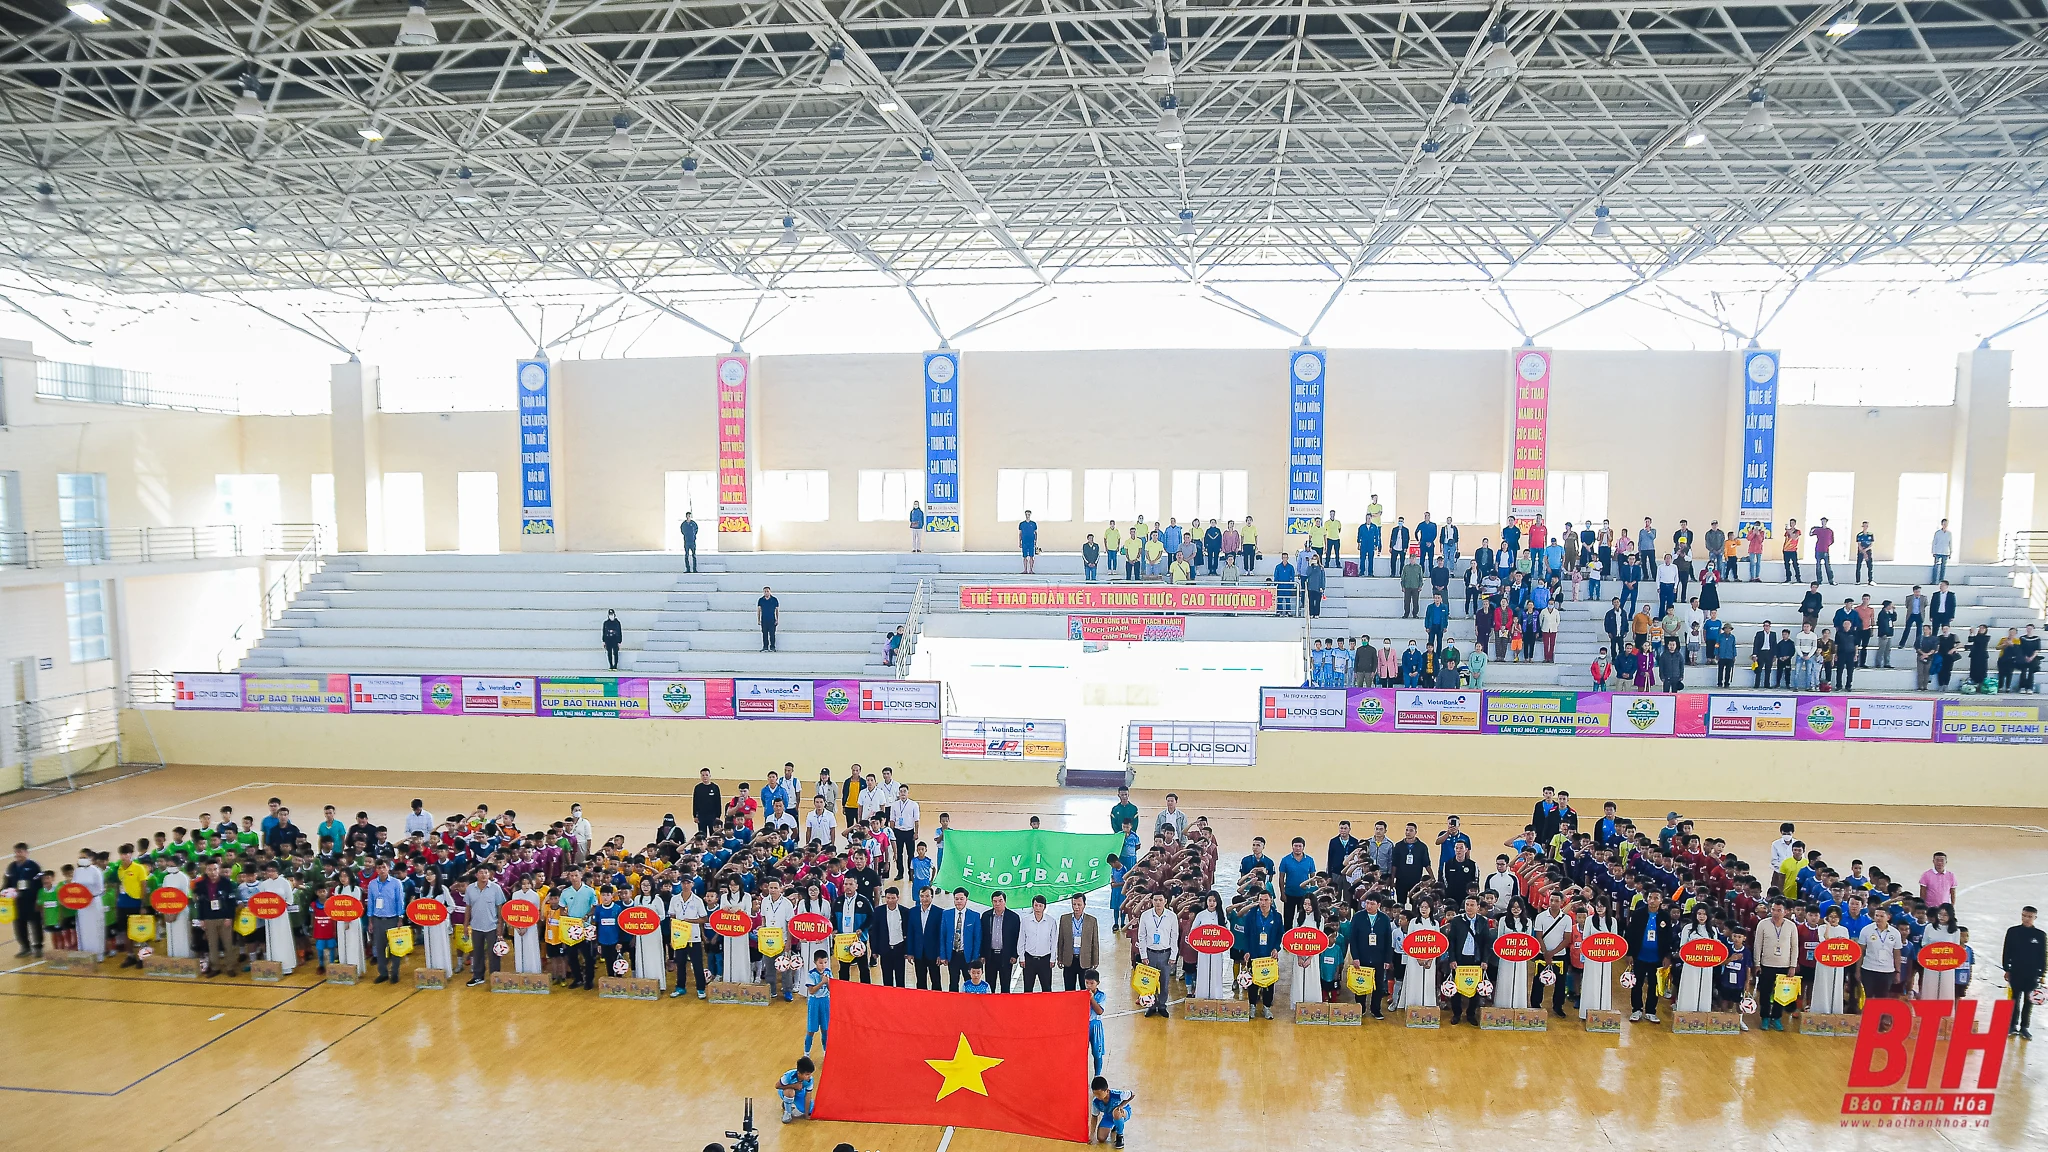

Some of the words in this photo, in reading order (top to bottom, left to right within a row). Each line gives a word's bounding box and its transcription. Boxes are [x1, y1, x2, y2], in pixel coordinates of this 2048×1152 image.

[931, 384, 940, 402] THỂ
[941, 384, 952, 402] THAO
[1519, 385, 1529, 400] THỂ
[1531, 385, 1544, 400] THAO
[1518, 408, 1533, 422] MANG
[1534, 408, 1544, 422] LẠI
[970, 588, 992, 605] THỂ
[997, 592, 1027, 605] THAO
[1031, 590, 1065, 605] ĐOÀN
[1068, 589, 1096, 607] KẾT,
[1101, 593, 1138, 606] TRUNG
[1143, 591, 1177, 608] THỰC,
[1181, 593, 1205, 606] CAO
[1210, 592, 1256, 608] THƯỢNG
[1261, 594, 1265, 606] !
[248, 694, 264, 702] CUP
[292, 694, 320, 703] THANH
[542, 699, 560, 707] CUP
[586, 700, 616, 708] THANH
[1288, 708, 1318, 716] LONG
[1489, 714, 1508, 722] CUP
[1539, 716, 1574, 724] THANH
[1578, 714, 1599, 724] HÓA
[1944, 724, 1966, 732] CUP
[2002, 724, 2039, 733] THANH
[1170, 743, 1211, 752] LONG
[1215, 744, 1246, 752] SON
[967, 854, 1099, 868] LIVING
[794, 921, 816, 934] TRỌNG
[816, 921, 828, 933] TÀI
[1202, 928, 1220, 938] HUYỆN
[1294, 932, 1316, 941] HUYỆN
[1415, 934, 1436, 943] HUYỆN
[1506, 938, 1517, 948] THỊ
[1518, 938, 1528, 946] XÃ
[1594, 938, 1614, 947] HUYỆN
[1193, 939, 1210, 948] QUẢNG
[1212, 940, 1230, 948] XƯƠNG
[1290, 942, 1303, 951] YÊN
[1304, 944, 1320, 953] ĐỊNH
[1828, 944, 1848, 952] HUYỆN
[1410, 946, 1426, 954] QUAN
[1428, 946, 1440, 954] HÓA
[1500, 948, 1517, 956] NGHI
[1518, 948, 1532, 957] SƠN
[1696, 944, 1714, 953] HUYỆN
[1588, 950, 1606, 958] THIỆU
[1607, 949, 1620, 958] HÓA
[1822, 954, 1830, 962] BÁ
[1832, 954, 1852, 962] THƯỚC
[1686, 954, 1703, 964] THẠCH
[1704, 954, 1722, 964] THÀNH
